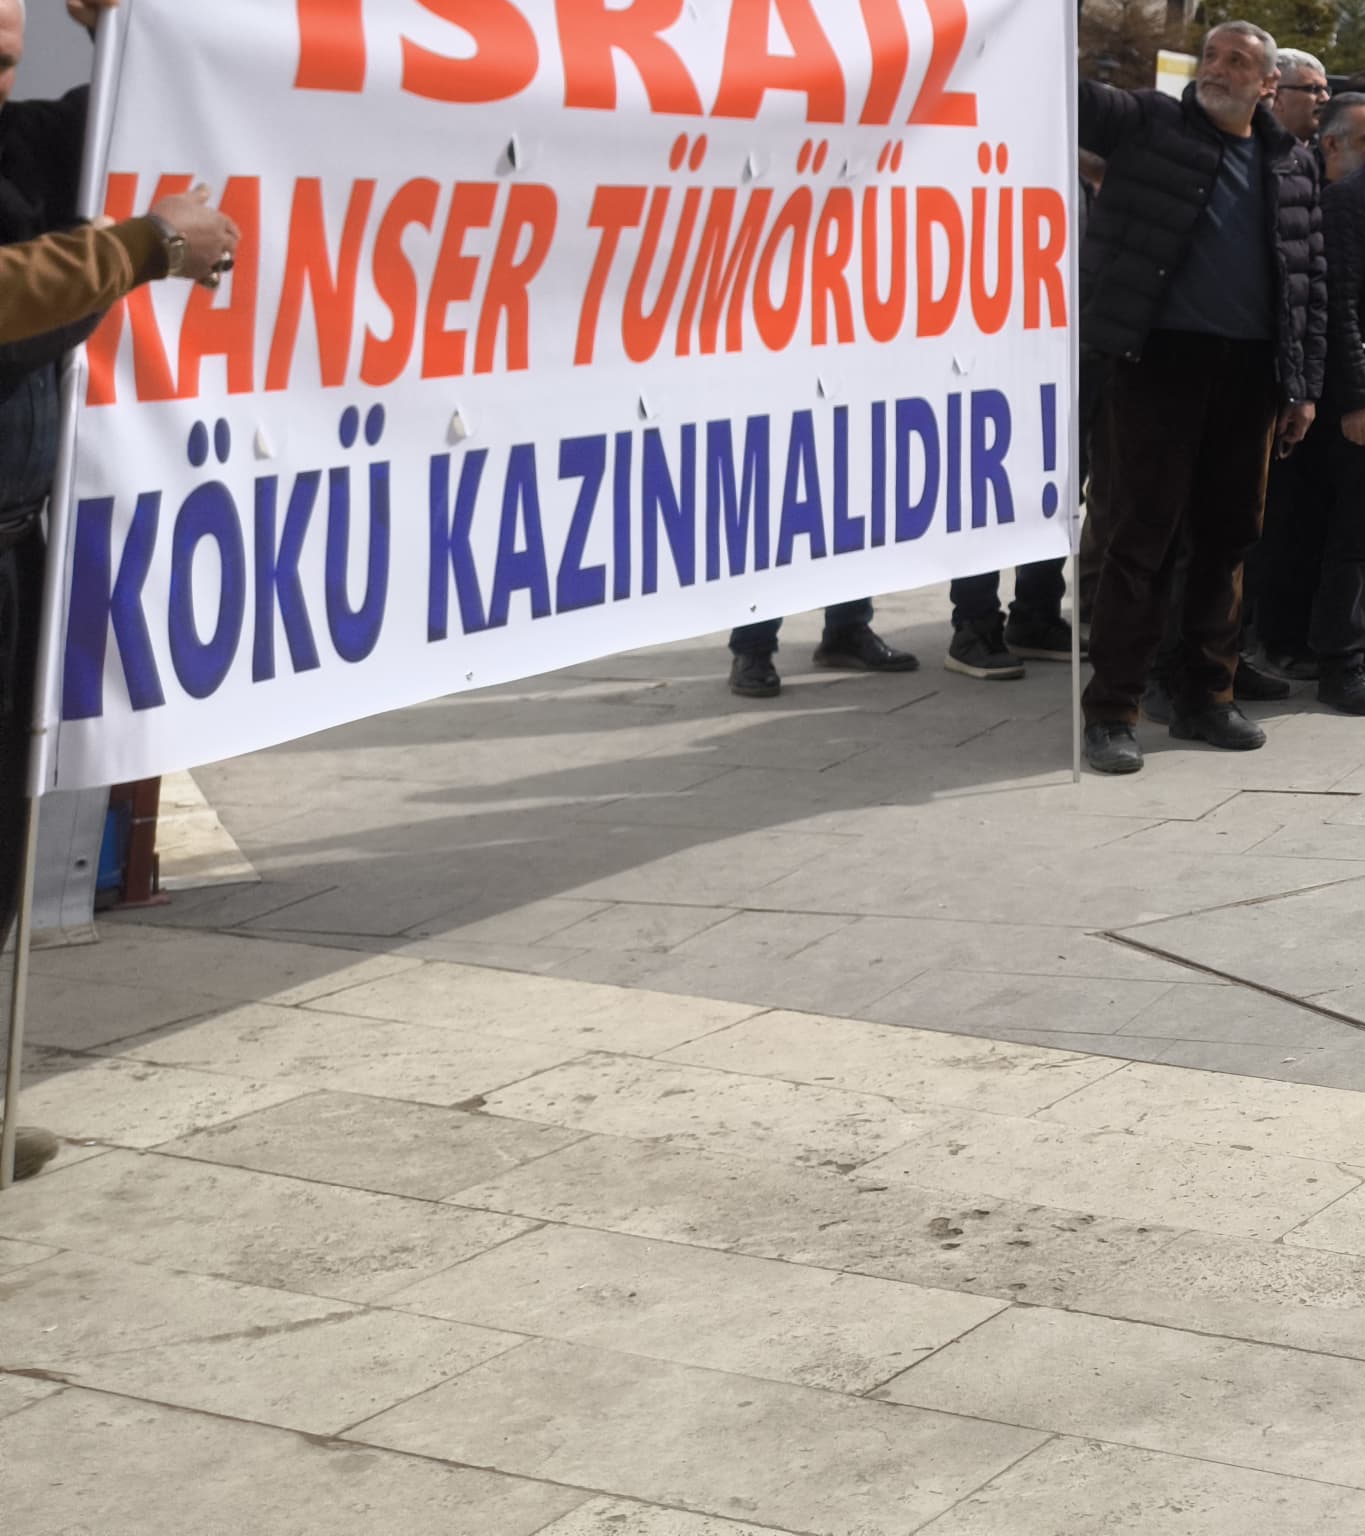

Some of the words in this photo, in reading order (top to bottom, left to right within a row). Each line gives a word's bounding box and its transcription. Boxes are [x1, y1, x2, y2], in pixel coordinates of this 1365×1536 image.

[84, 171, 559, 407] KANSER
[573, 133, 1068, 366] TÜMÖRÜDÜR
[62, 402, 391, 721] KÖKÜ
[427, 388, 1014, 643] KAZINMALIDIR
[1038, 383, 1059, 520] !
